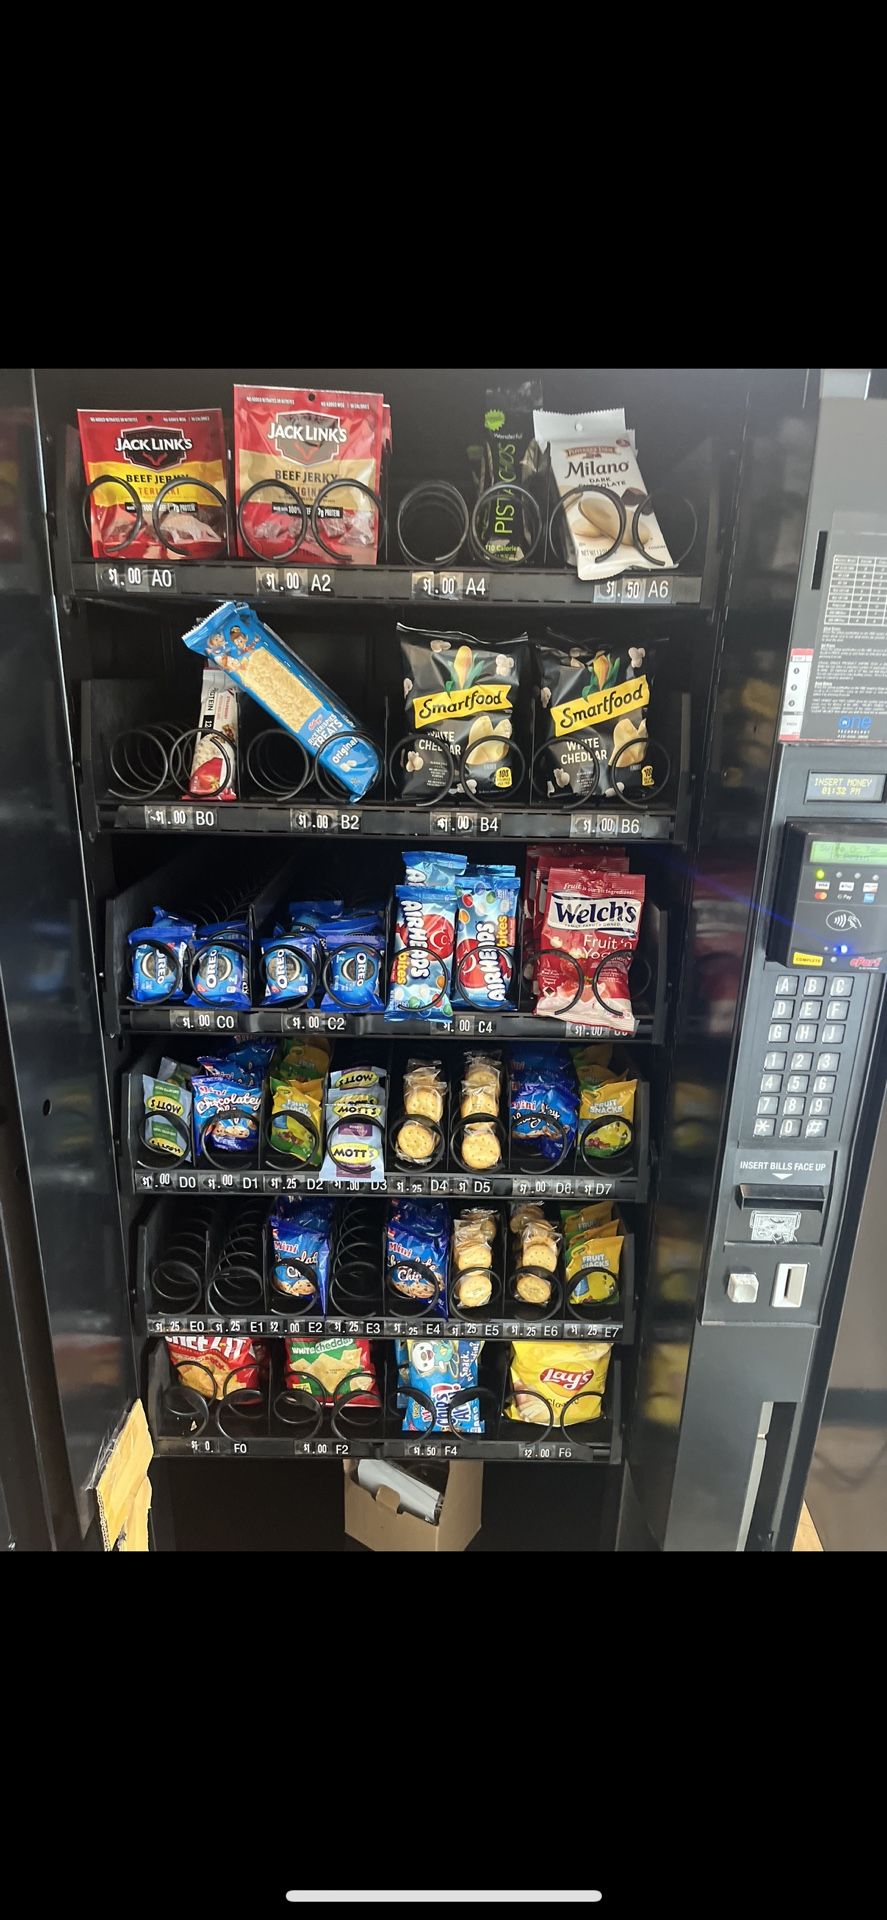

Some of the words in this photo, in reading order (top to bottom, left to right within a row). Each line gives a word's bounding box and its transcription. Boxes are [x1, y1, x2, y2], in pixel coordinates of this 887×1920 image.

[268, 422, 304, 442] JACK
[115, 438, 151, 451] JACK
[274, 470, 301, 481] BEEF
[565, 460, 629, 478] Milano
[126, 474, 152, 483] BEEF
[108, 567, 140, 586] $1.00
[151, 570, 172, 587] A0
[266, 572, 299, 591] $1.00
[311, 574, 331, 592] A2
[466, 578, 486, 595] A4
[648, 580, 668, 597] A6
[419, 690, 502, 719] Smartfood
[560, 684, 644, 728] Smartfood
[313, 720, 343, 748] TREATS
[419, 739, 461, 755] CHEAR
[815, 778, 843, 786] INSERT
[847, 778, 872, 787] MONEY
[196, 811, 214, 826] B0
[341, 815, 359, 829] B2
[480, 817, 498, 832] B4
[621, 819, 640, 833] B6
[554, 902, 636, 924] Welch's
[497, 915, 508, 947] bites
[584, 934, 617, 949] Fruit
[476, 922, 506, 1001] AIRHEDS
[206, 950, 218, 988] OREO
[277, 949, 288, 989] OREO
[356, 952, 367, 987] OREO
[397, 952, 410, 985] bites
[780, 978, 788, 992] A
[808, 979, 817, 992] B
[836, 980, 845, 993] C
[778, 1002, 786, 1015] D
[804, 1002, 812, 1015] E
[831, 1003, 841, 1016] F
[216, 1016, 234, 1028] C0
[328, 1017, 345, 1030] C2
[478, 1021, 493, 1033] C4
[774, 1026, 782, 1039] G
[800, 1026, 809, 1039] H
[828, 1027, 835, 1040] J
[771, 1054, 776, 1067] 1
[796, 1054, 804, 1067] 2
[823, 1055, 831, 1068] 3
[765, 1076, 774, 1088] 4
[792, 1077, 800, 1089] 5
[818, 1078, 827, 1090] 6
[594, 1100, 617, 1108] FRUIT
[762, 1099, 770, 1111] 7
[788, 1099, 797, 1112] 8
[815, 1100, 823, 1112] 9
[785, 1121, 793, 1133] 0
[808, 1121, 823, 1133] #
[740, 1161, 768, 1170] INSERT
[770, 1162, 793, 1170] BILLS
[794, 1163, 814, 1171] FACE
[180, 1178, 196, 1188] D0
[243, 1178, 258, 1188] D1
[307, 1179, 323, 1190] D2
[371, 1181, 387, 1190] D3
[431, 1181, 446, 1191] D4
[474, 1182, 491, 1193] D5
[596, 1184, 612, 1195] D7
[274, 1241, 299, 1255] Mini
[389, 1242, 412, 1258] Mini
[583, 1254, 604, 1262] FRUIT
[398, 1268, 422, 1282] Chip
[190, 1321, 204, 1331] E0
[251, 1322, 264, 1332] E1
[309, 1322, 322, 1332] E2
[367, 1323, 380, 1333] E3
[426, 1324, 440, 1334] E4
[485, 1325, 499, 1335] E5
[544, 1326, 558, 1336] E6
[605, 1327, 619, 1337] E7
[543, 1368, 592, 1390] Lay's
[234, 1443, 247, 1453] F0
[336, 1445, 349, 1455] F2
[444, 1446, 457, 1456] F4
[559, 1448, 572, 1457] F6
